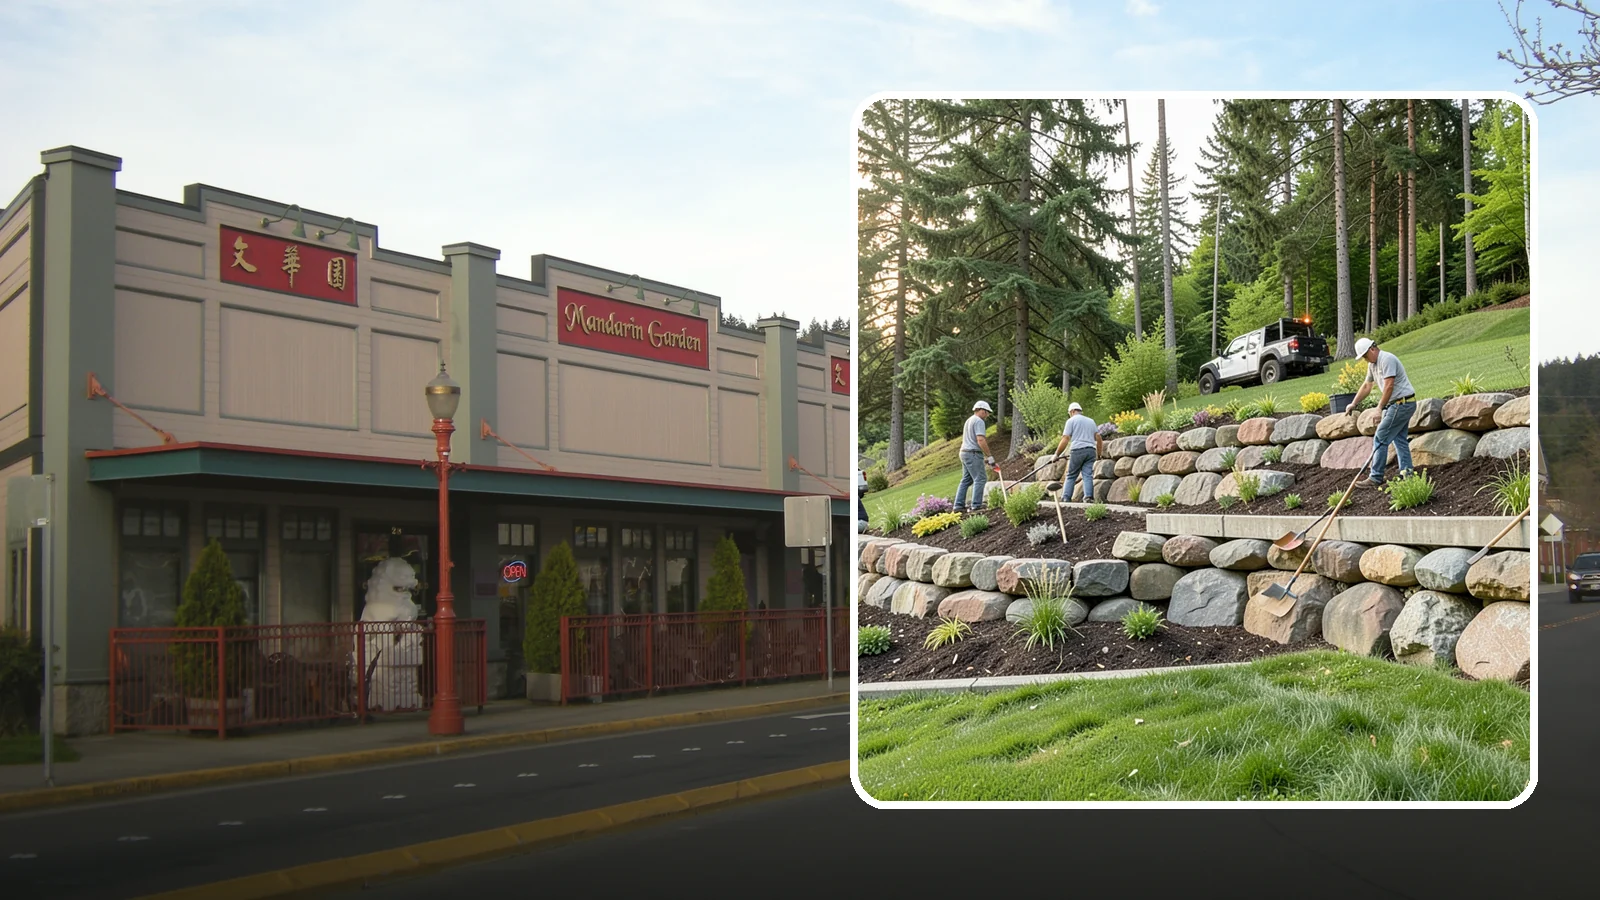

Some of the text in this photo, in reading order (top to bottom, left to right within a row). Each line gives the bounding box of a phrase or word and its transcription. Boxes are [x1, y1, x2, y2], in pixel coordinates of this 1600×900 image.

[230, 235, 346, 291] 文華園
[564, 302, 702, 352] Mandarin Garden
[503, 565, 527, 578] OPEN
